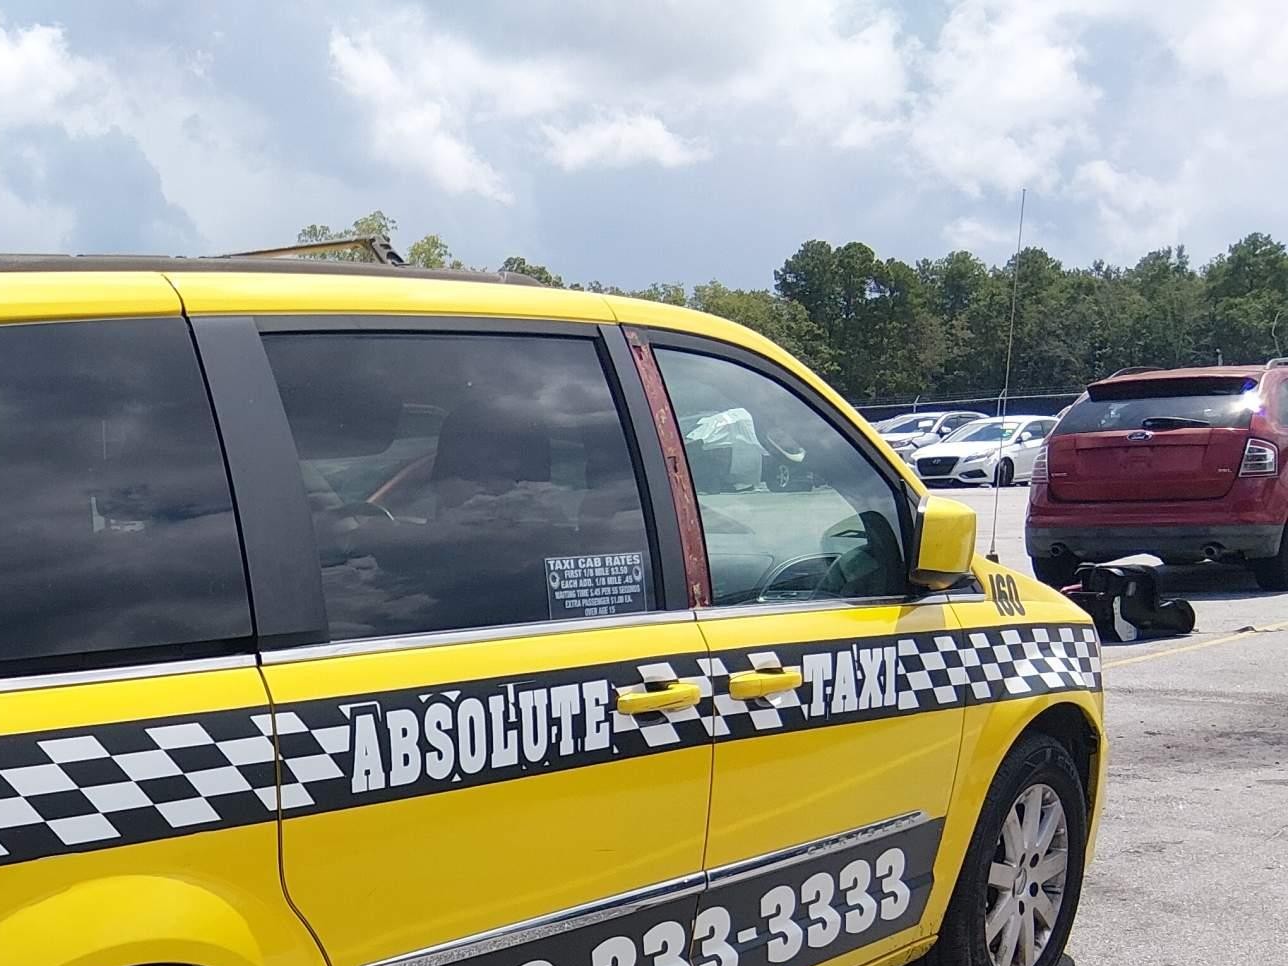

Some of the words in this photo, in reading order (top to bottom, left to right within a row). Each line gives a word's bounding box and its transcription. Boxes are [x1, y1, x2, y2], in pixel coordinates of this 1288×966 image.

[548, 559, 575, 570] TAXI
[578, 557, 602, 569] CAB
[605, 555, 641, 567] RATES
[564, 569, 582, 579] FIRST
[560, 578, 578, 588] EACH
[988, 573, 1026, 617] 160
[352, 679, 611, 794] ABSOLUTE
[803, 646, 897, 717] TAXI
